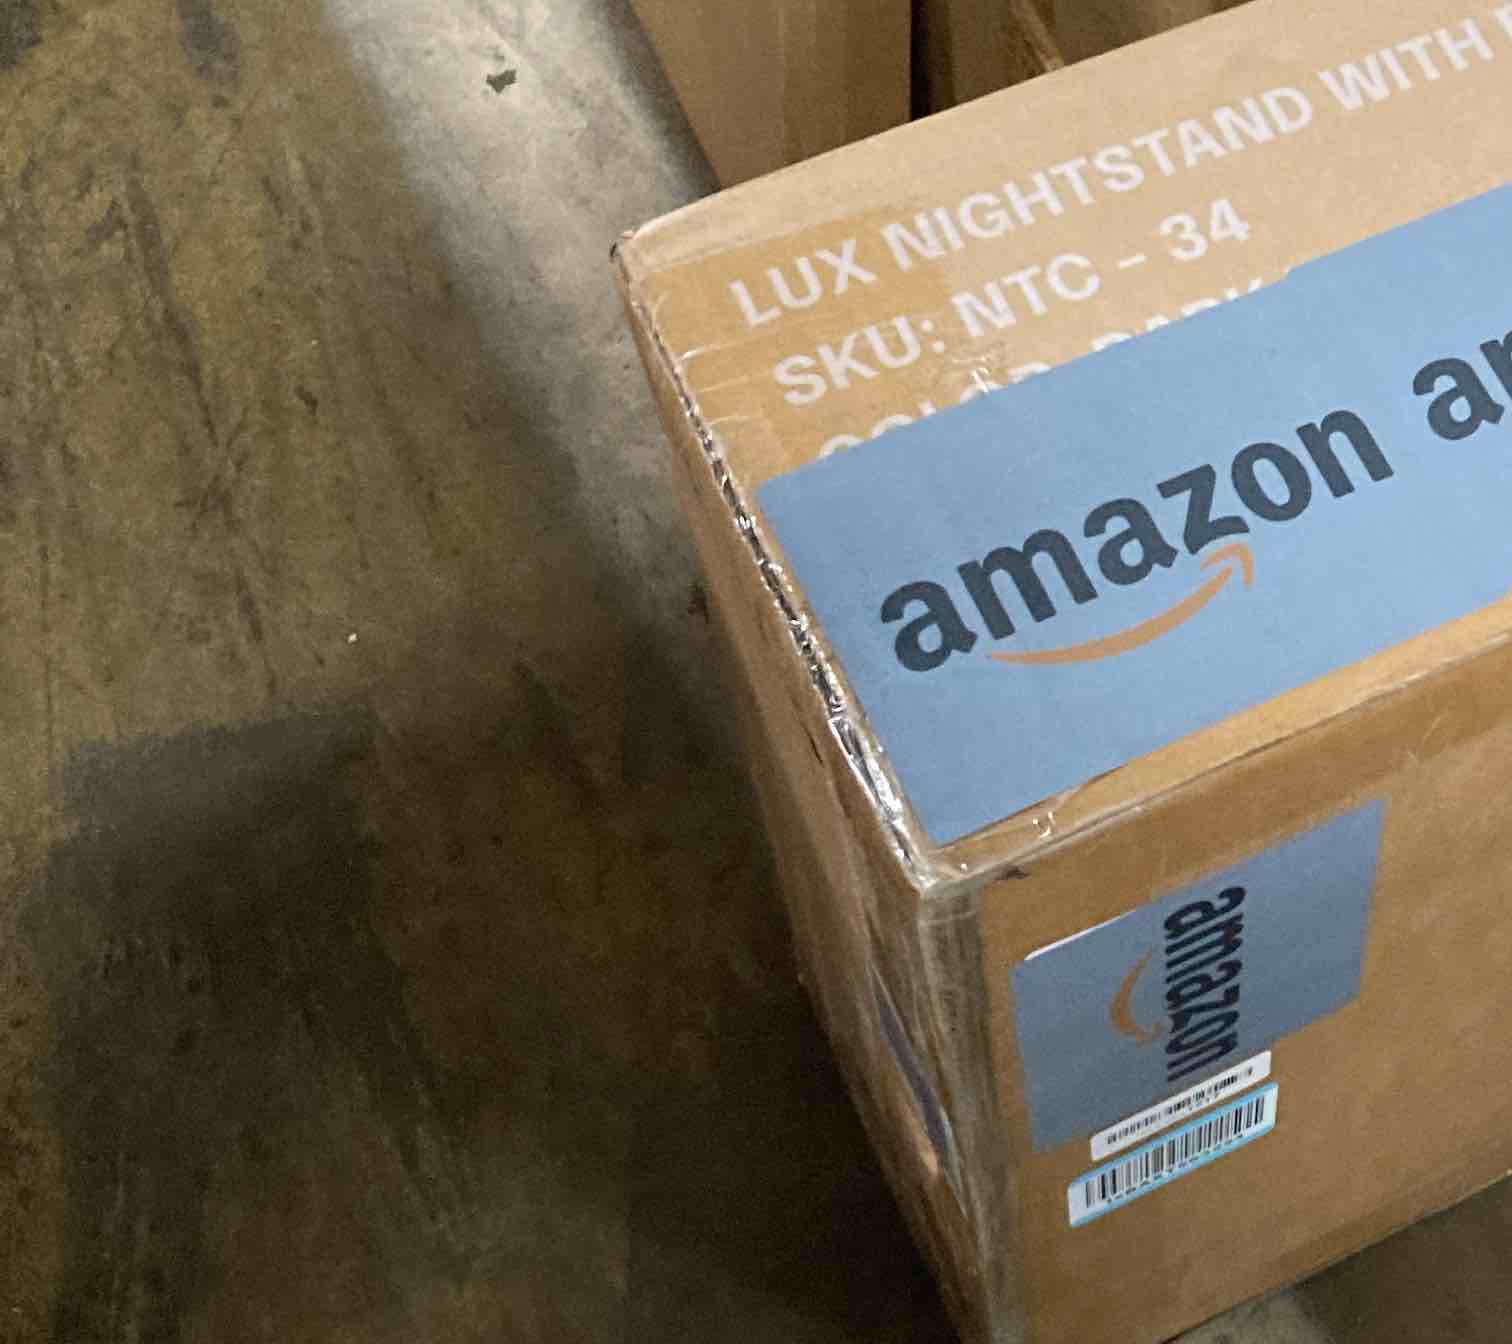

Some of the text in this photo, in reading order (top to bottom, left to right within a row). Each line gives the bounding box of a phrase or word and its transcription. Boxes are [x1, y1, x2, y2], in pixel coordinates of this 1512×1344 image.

[729, 240, 876, 327] LUX
[879, 85, 1314, 263] NIGHTSTAND
[1319, 19, 1495, 112] WITH
[774, 315, 946, 406] SKU:
[953, 253, 1101, 338] NTC
[1159, 198, 1252, 261] 34
[879, 408, 1396, 674] amazon
[1164, 886, 1246, 1084] amazon
